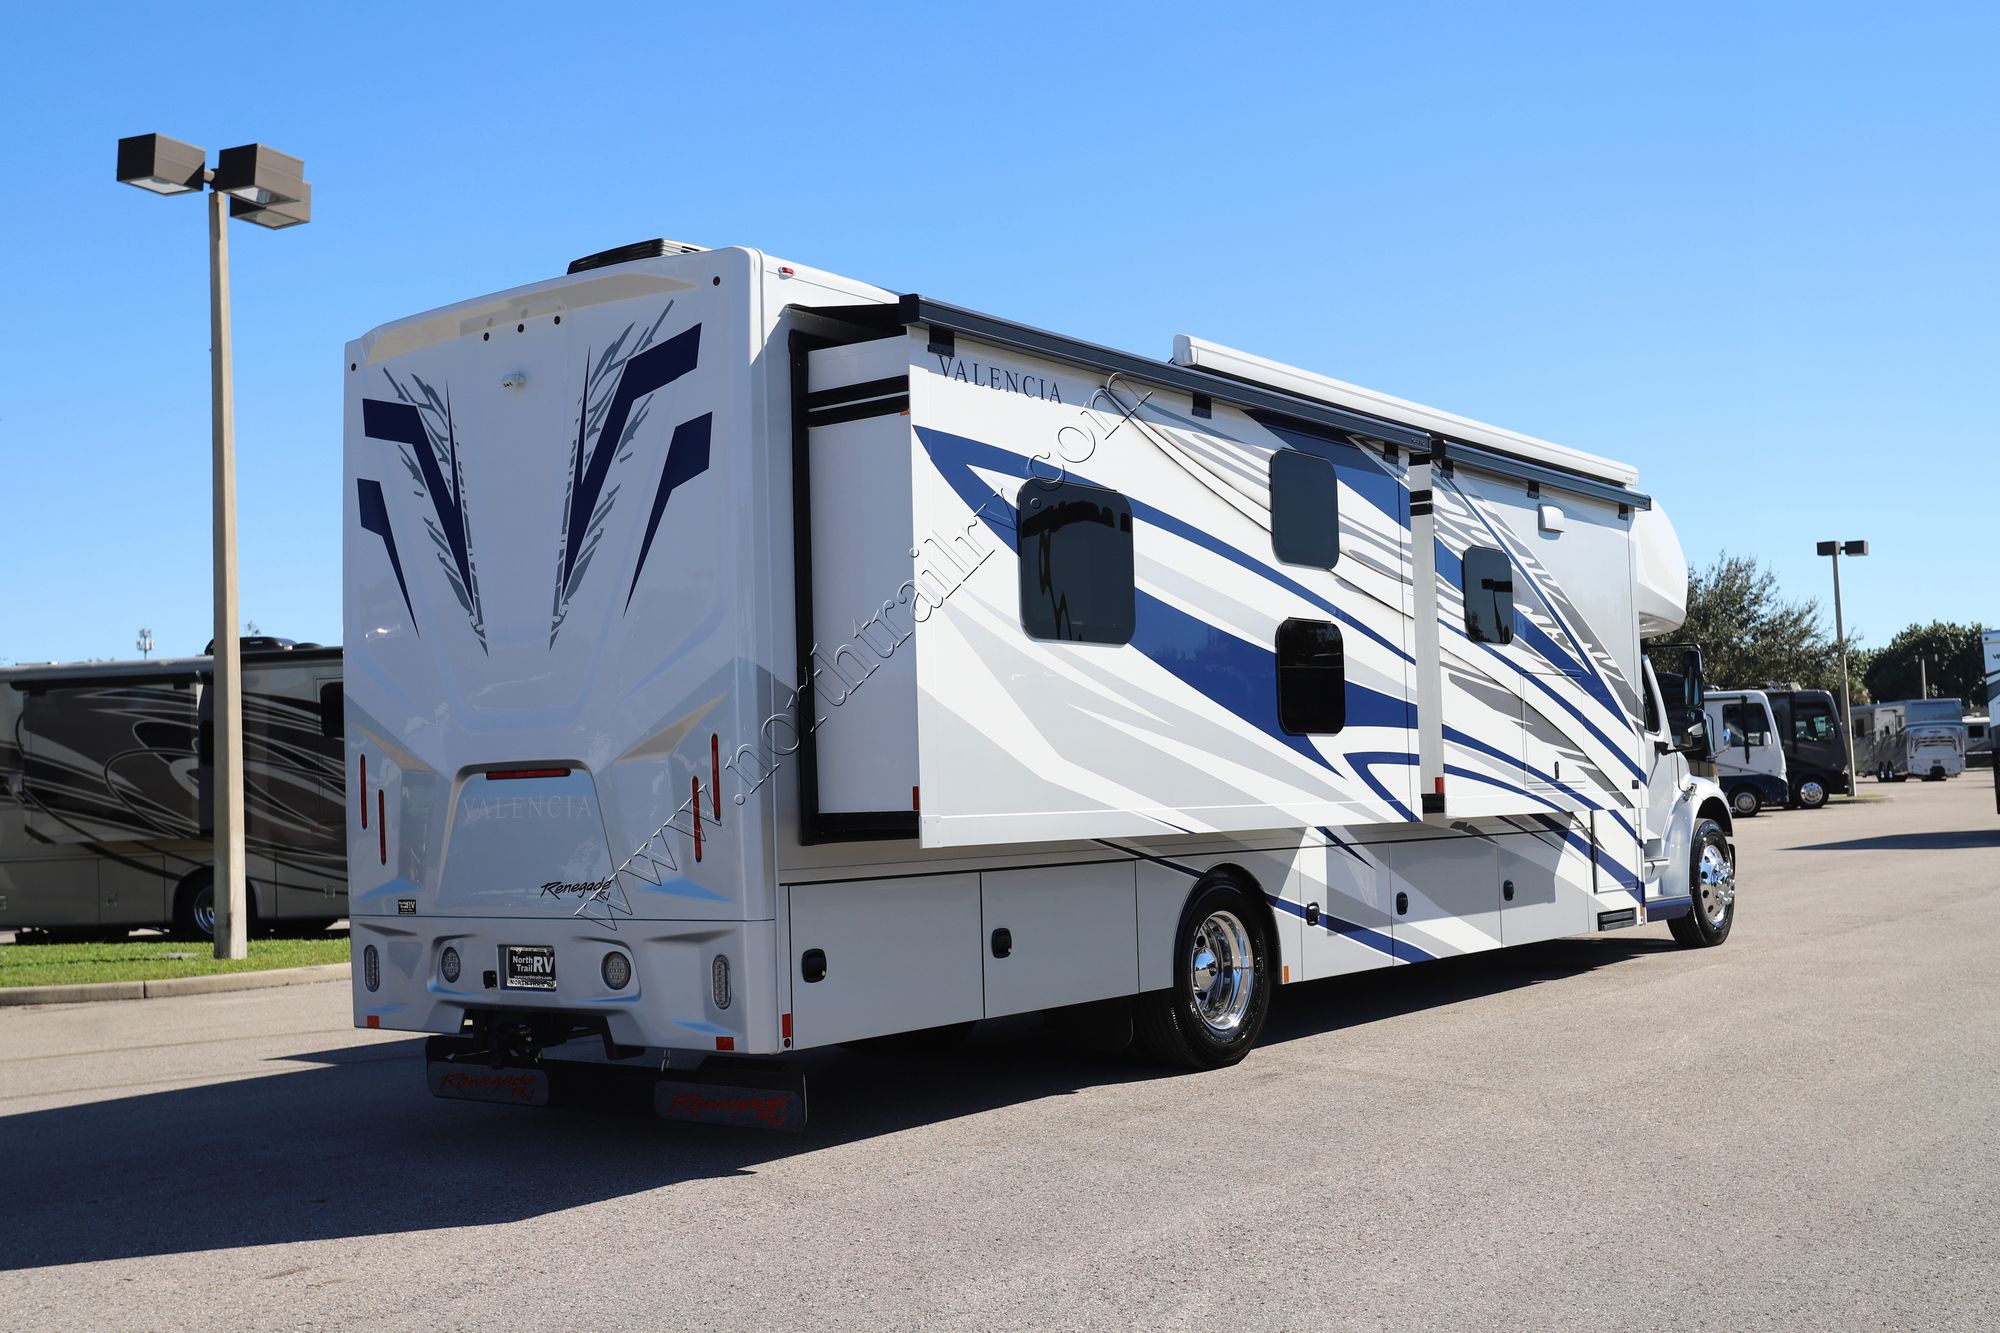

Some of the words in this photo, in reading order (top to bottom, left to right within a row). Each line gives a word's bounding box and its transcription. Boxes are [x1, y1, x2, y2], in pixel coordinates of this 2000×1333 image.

[937, 354, 1062, 404] VALENCIA
[462, 795, 593, 820] VALENCIA
[540, 876, 614, 900] Renegade
[512, 955, 533, 964] North
[516, 964, 533, 973] Trail
[533, 956, 554, 974] RV
